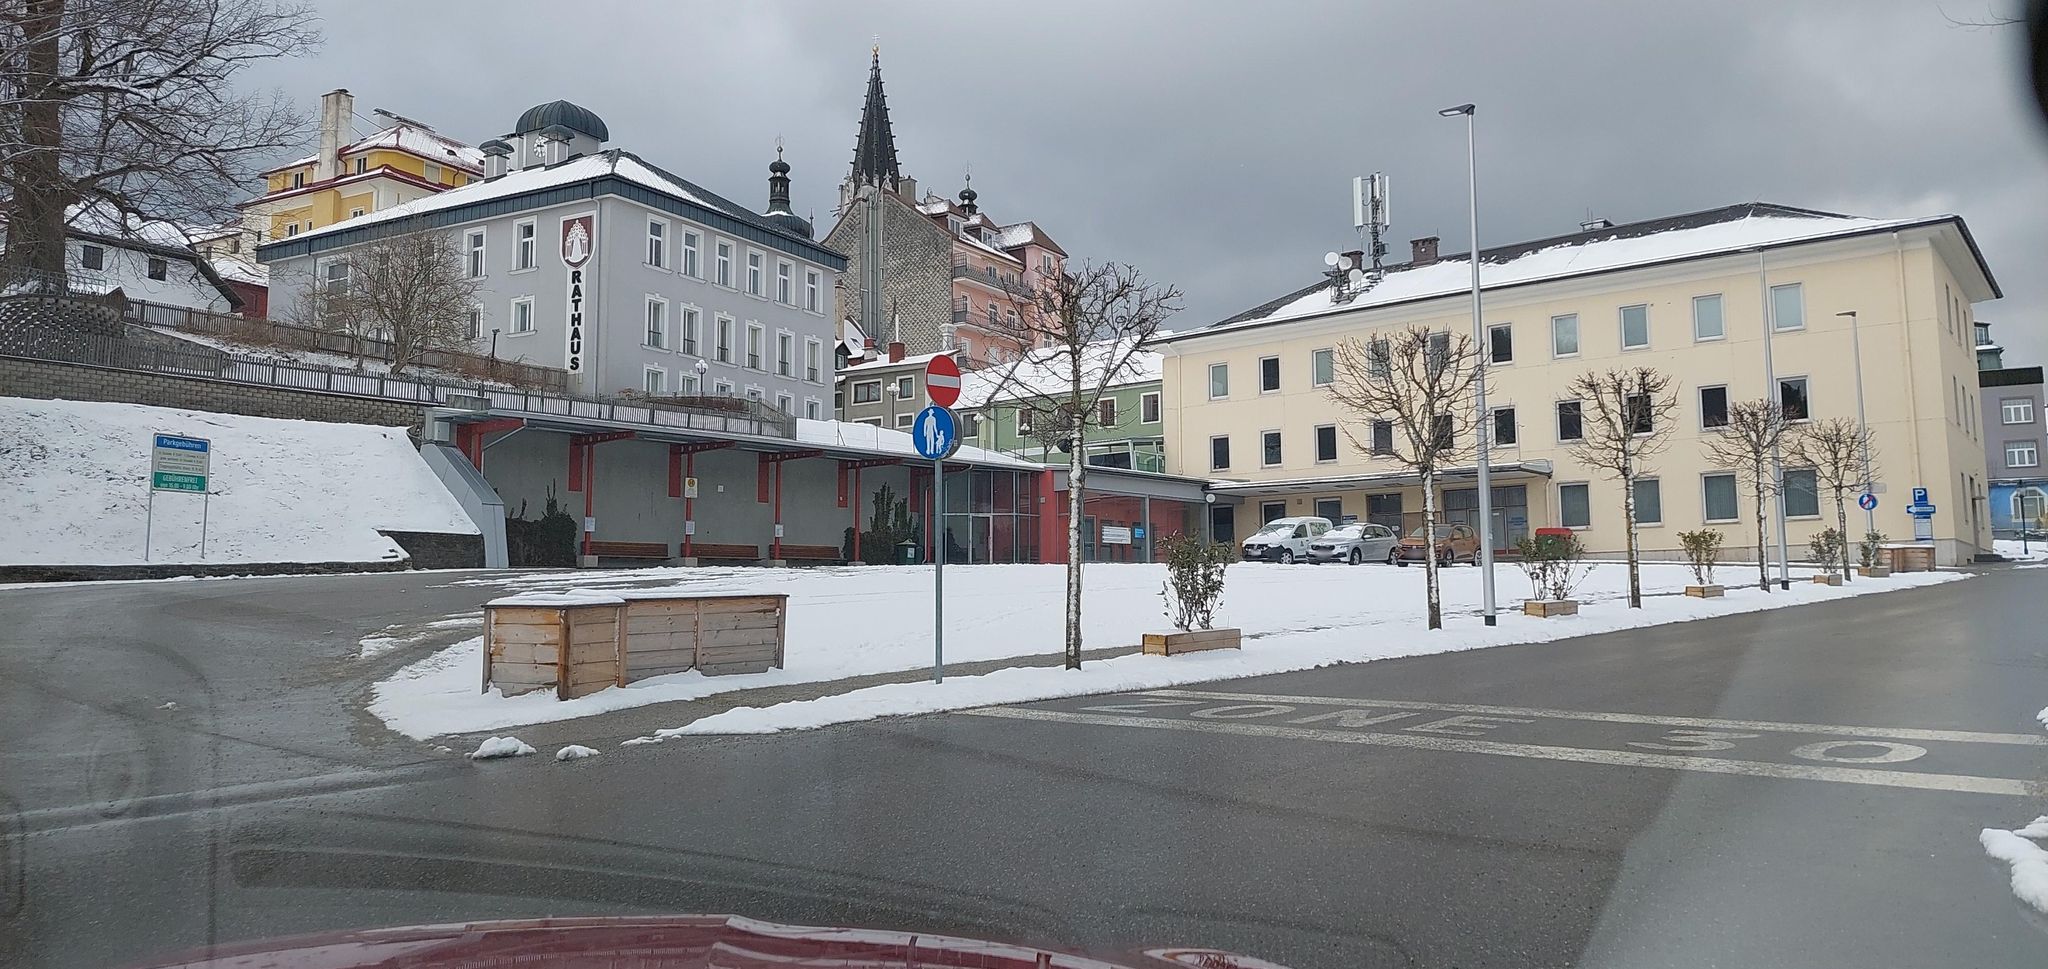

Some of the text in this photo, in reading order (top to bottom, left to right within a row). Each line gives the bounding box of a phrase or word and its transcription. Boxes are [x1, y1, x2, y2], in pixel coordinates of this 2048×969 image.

[570, 270, 582, 370] RATHAUS
[163, 438, 202, 449] Parkgebühren
[162, 474, 198, 484] GEBÜHRENFREI
[1914, 489, 1925, 501] P
[1080, 698, 1928, 764] ZONE 30
